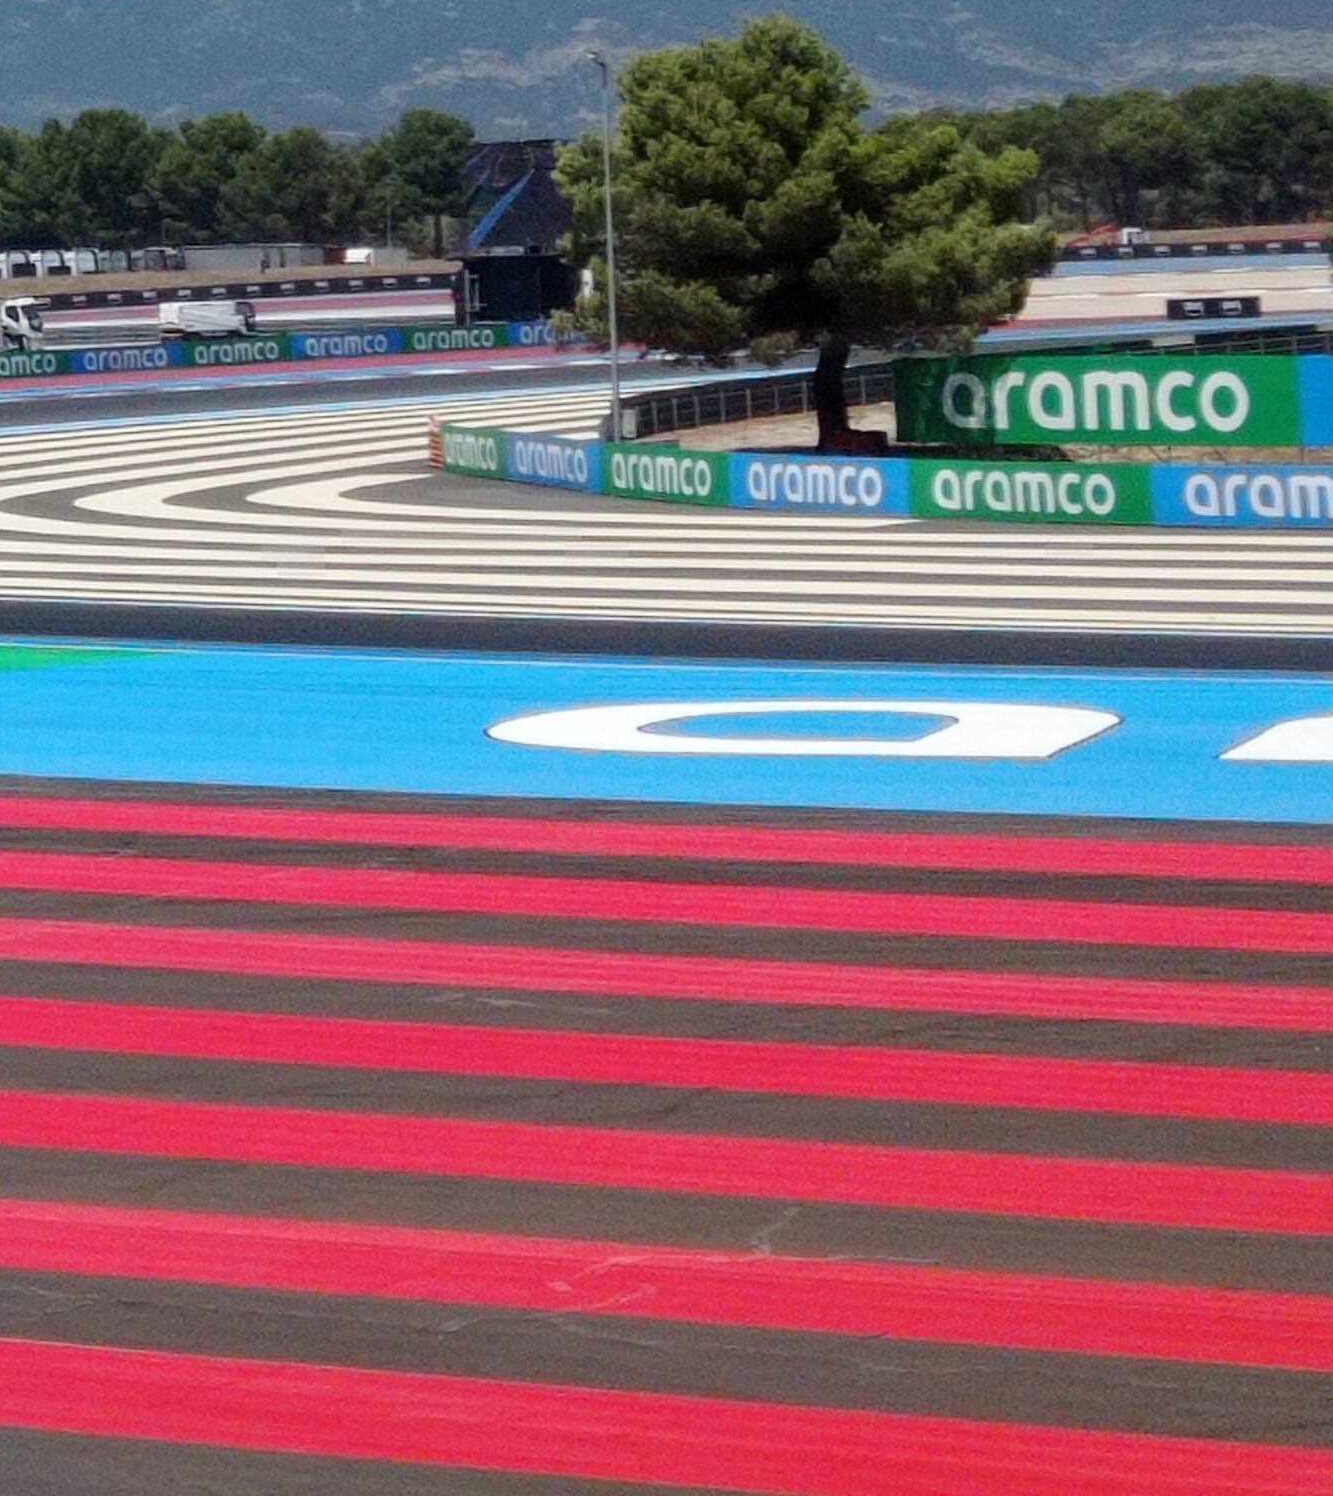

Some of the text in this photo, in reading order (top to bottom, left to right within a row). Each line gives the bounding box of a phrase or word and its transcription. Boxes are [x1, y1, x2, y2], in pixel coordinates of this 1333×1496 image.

[83, 345, 167, 370] aramco
[194, 339, 279, 364] aramco
[306, 333, 387, 356] aramco
[413, 327, 494, 349] aramco
[942, 371, 1250, 432] aramco
[445, 433, 498, 471] aramco
[516, 441, 588, 482] aramco
[612, 453, 711, 496] aramco
[748, 461, 883, 506] aramco
[934, 469, 1115, 515] aramco
